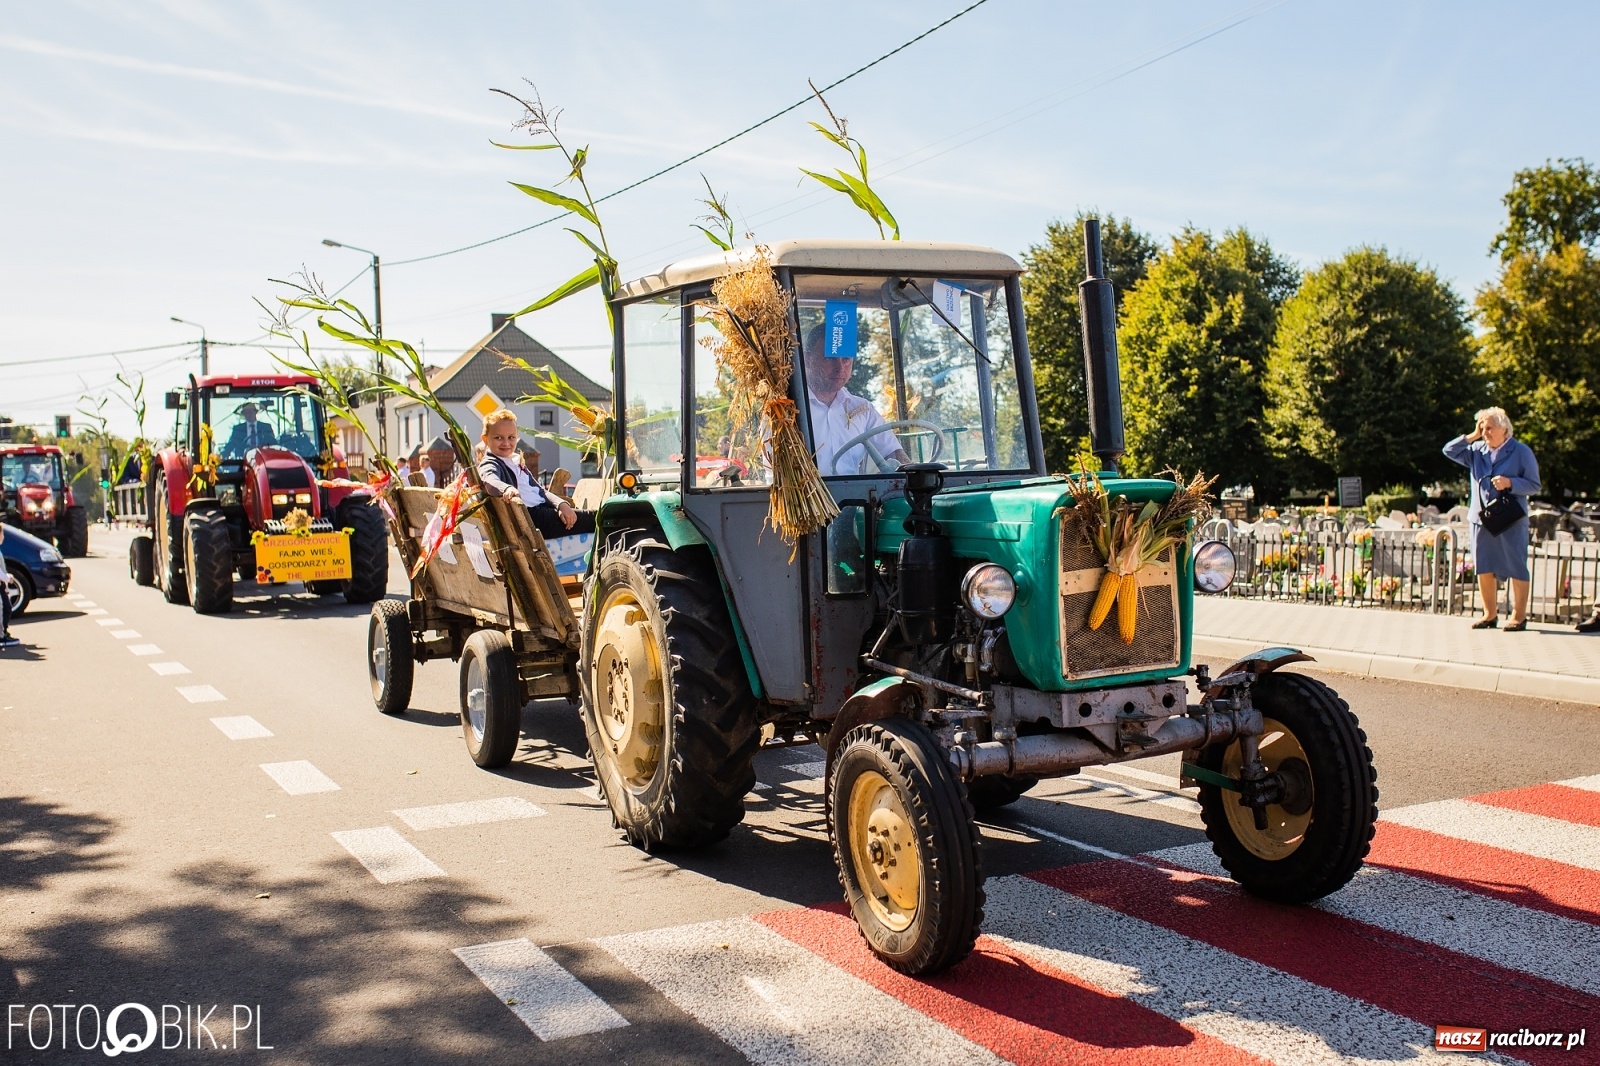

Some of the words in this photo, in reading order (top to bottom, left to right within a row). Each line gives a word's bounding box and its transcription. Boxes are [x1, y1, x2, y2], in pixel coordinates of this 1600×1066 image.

[831, 326, 839, 354] RUDNIK
[263, 537, 341, 547] GRZEGORZOWICE
[268, 560, 327, 569] GOSPODARZY
[287, 571, 302, 580] THE
